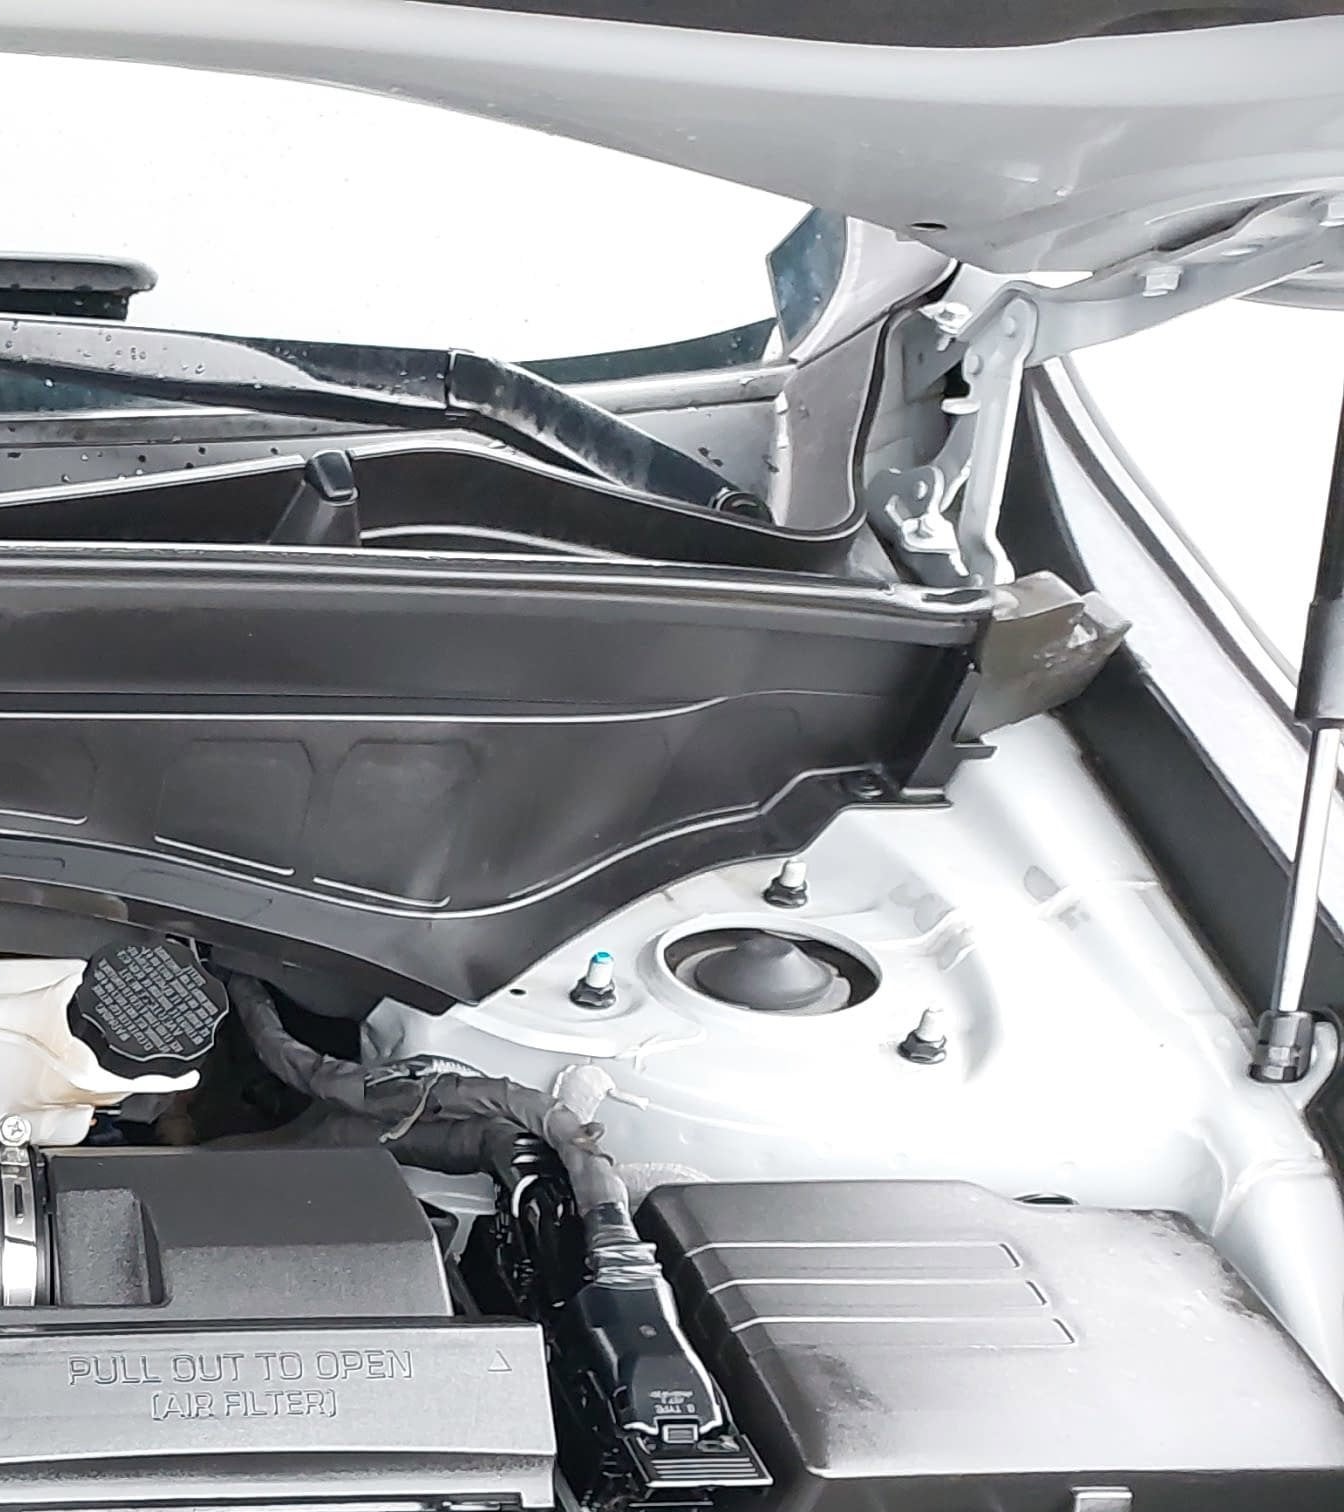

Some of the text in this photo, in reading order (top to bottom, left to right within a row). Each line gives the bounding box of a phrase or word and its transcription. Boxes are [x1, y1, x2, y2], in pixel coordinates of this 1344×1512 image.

[68, 1349, 413, 1386] PULL OUT TO OPEN
